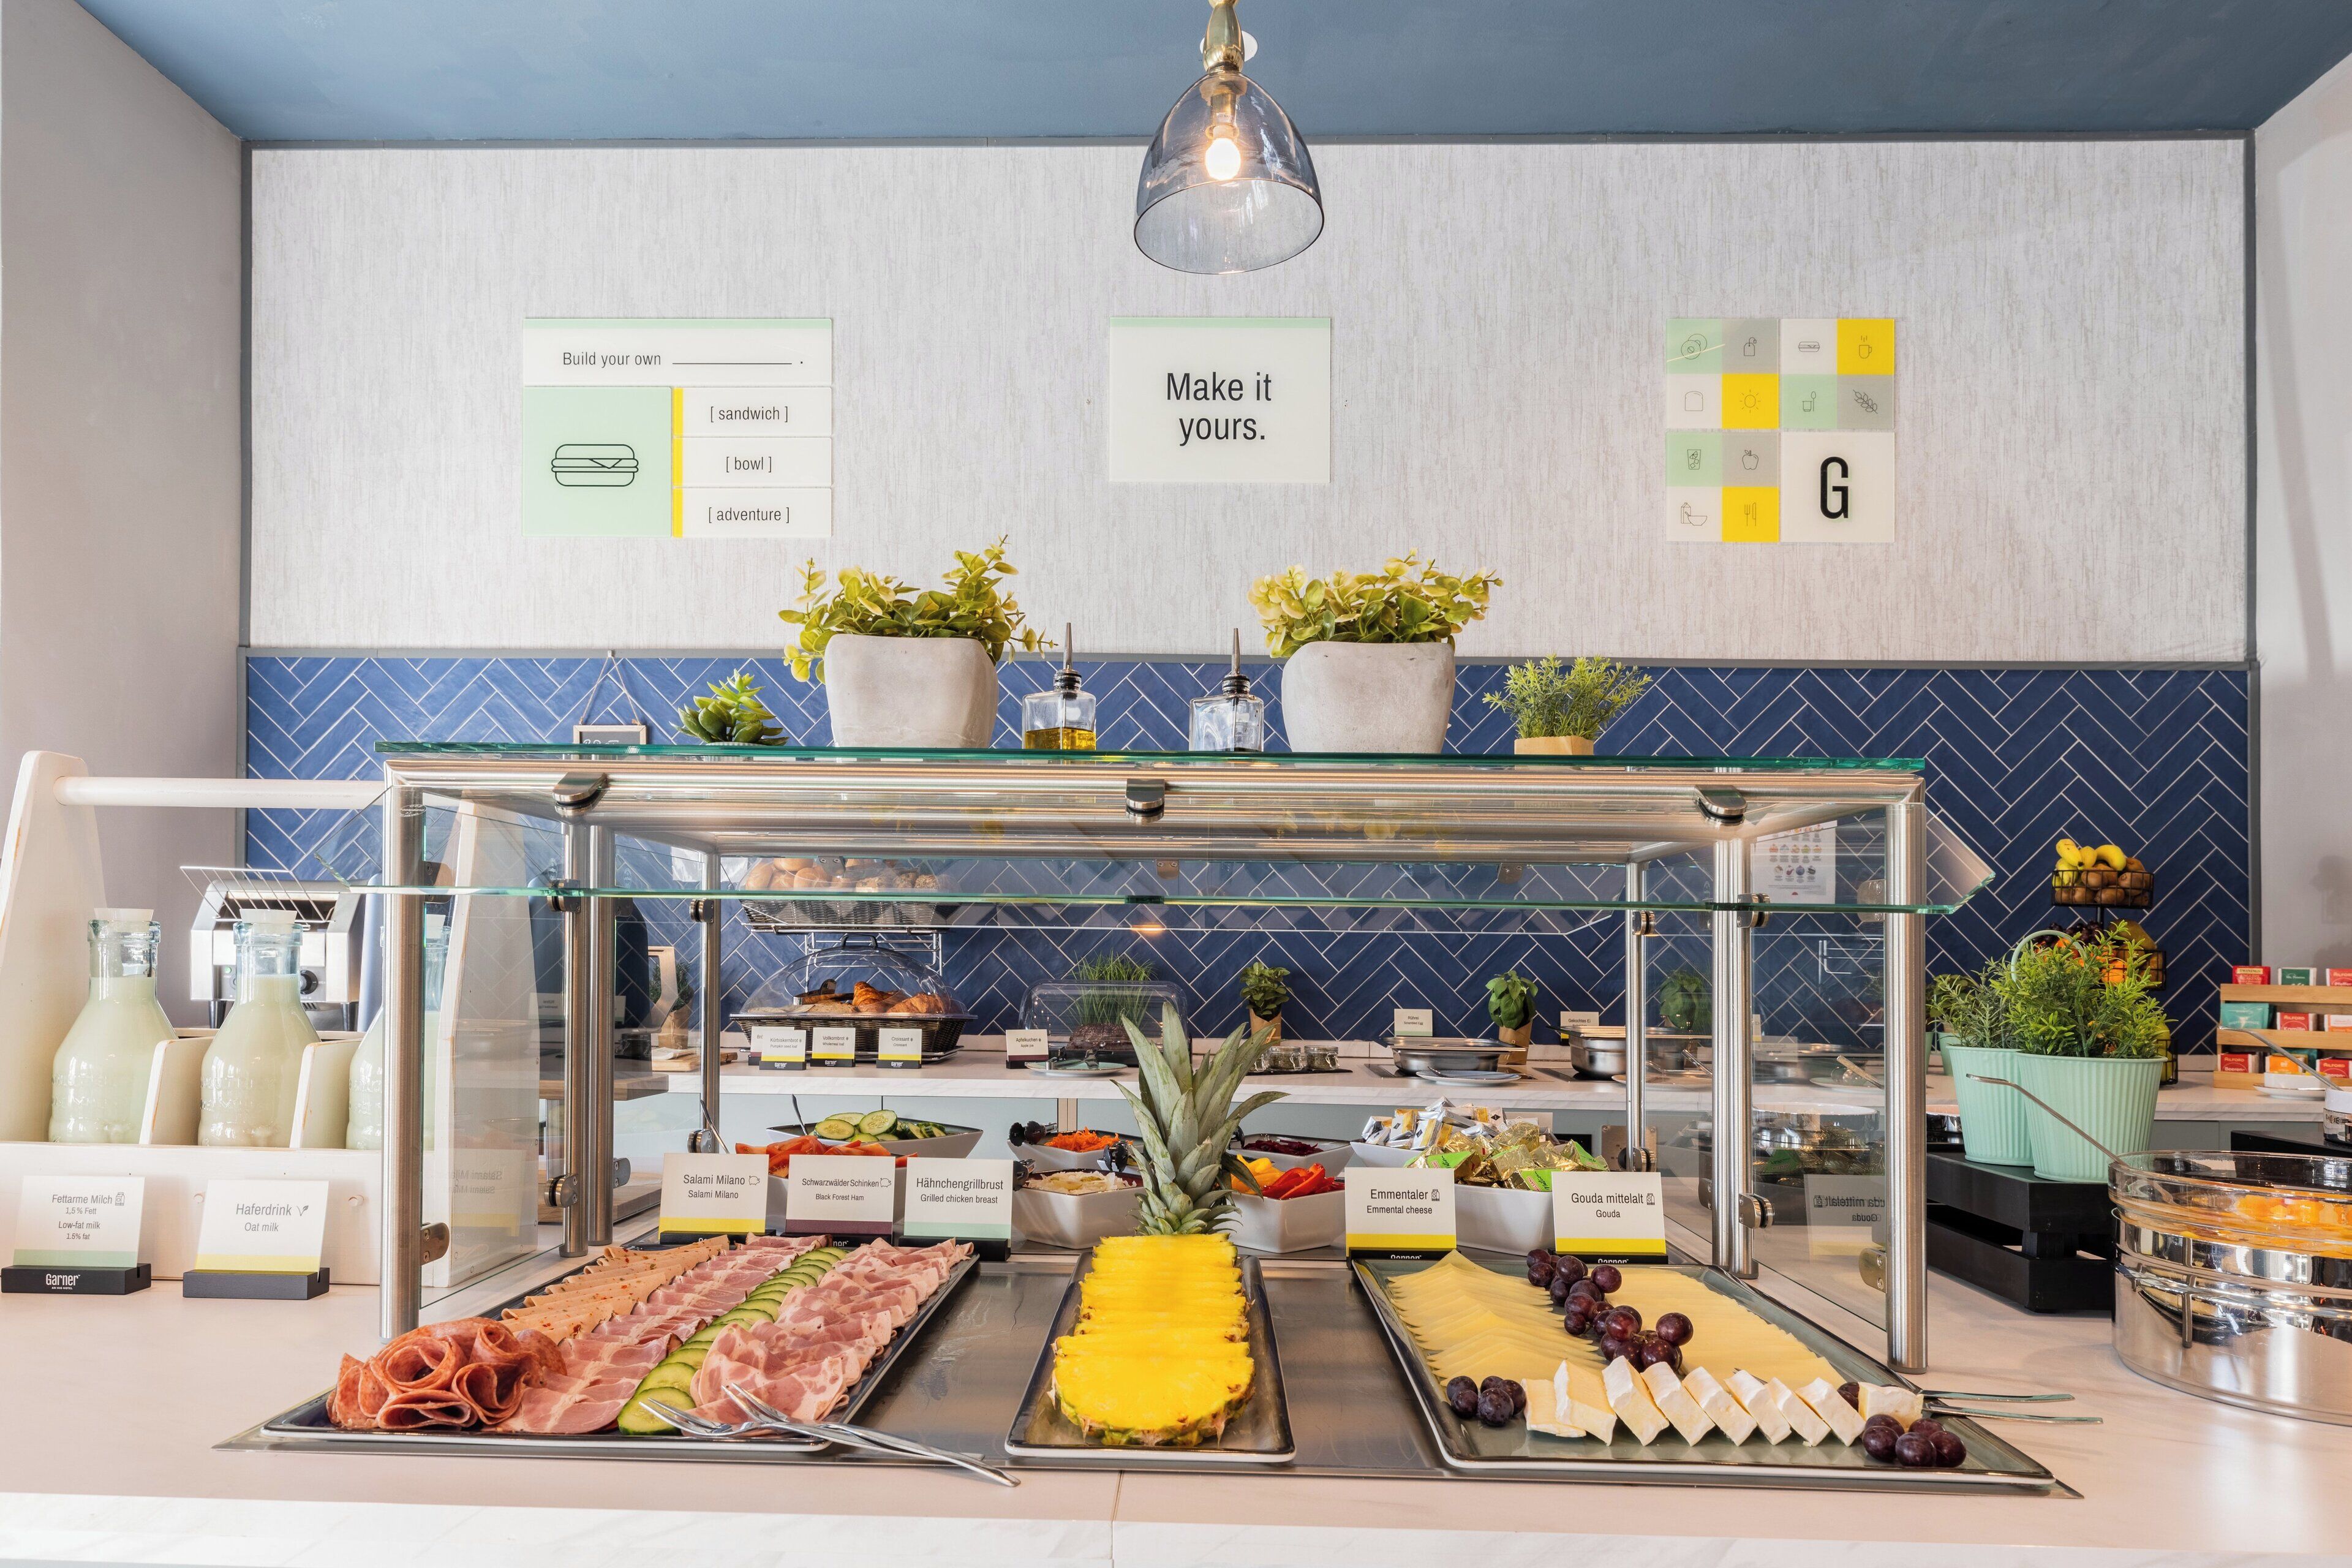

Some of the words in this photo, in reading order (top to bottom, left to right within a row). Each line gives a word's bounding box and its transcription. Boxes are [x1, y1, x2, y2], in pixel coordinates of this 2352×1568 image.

[563, 352, 596, 366] Build
[601, 355, 630, 369] your
[635, 355, 661, 366] own
[1167, 371, 1243, 401] Make
[1256, 371, 1272, 401] it
[718, 406, 780, 421] sandwich
[1179, 417, 1265, 447] yours.
[734, 457, 764, 471] bowl
[1820, 456, 1849, 519] G
[716, 507, 782, 522] adventure
[683, 1174, 714, 1186] Salami
[716, 1174, 745, 1186] Milano
[802, 1178, 850, 1188] Schwarzwälder
[850, 1178, 880, 1188] Schinken
[916, 1177, 1004, 1193] Hähnchengrillbrust
[52, 1194, 89, 1204] Fettarme
[91, 1195, 113, 1204] Milch
[688, 1189, 712, 1199] Salami
[714, 1190, 739, 1199] Milano
[921, 1194, 944, 1204] Grilled
[946, 1194, 973, 1204] chicken
[976, 1194, 998, 1204] breast
[1370, 1188, 1428, 1200] Emmentaler
[1571, 1193, 1604, 1204] Gouda
[1606, 1193, 1644, 1204] mittelalt
[236, 1204, 292, 1216] Haferdrink
[1366, 1205, 1404, 1215] Emmental
[1406, 1205, 1433, 1215] cheese
[1596, 1208, 1621, 1218] Gouda
[58, 1221, 84, 1229] Low-fat
[86, 1221, 100, 1229] milk
[244, 1223, 259, 1232] Oat
[261, 1223, 279, 1232] milk
